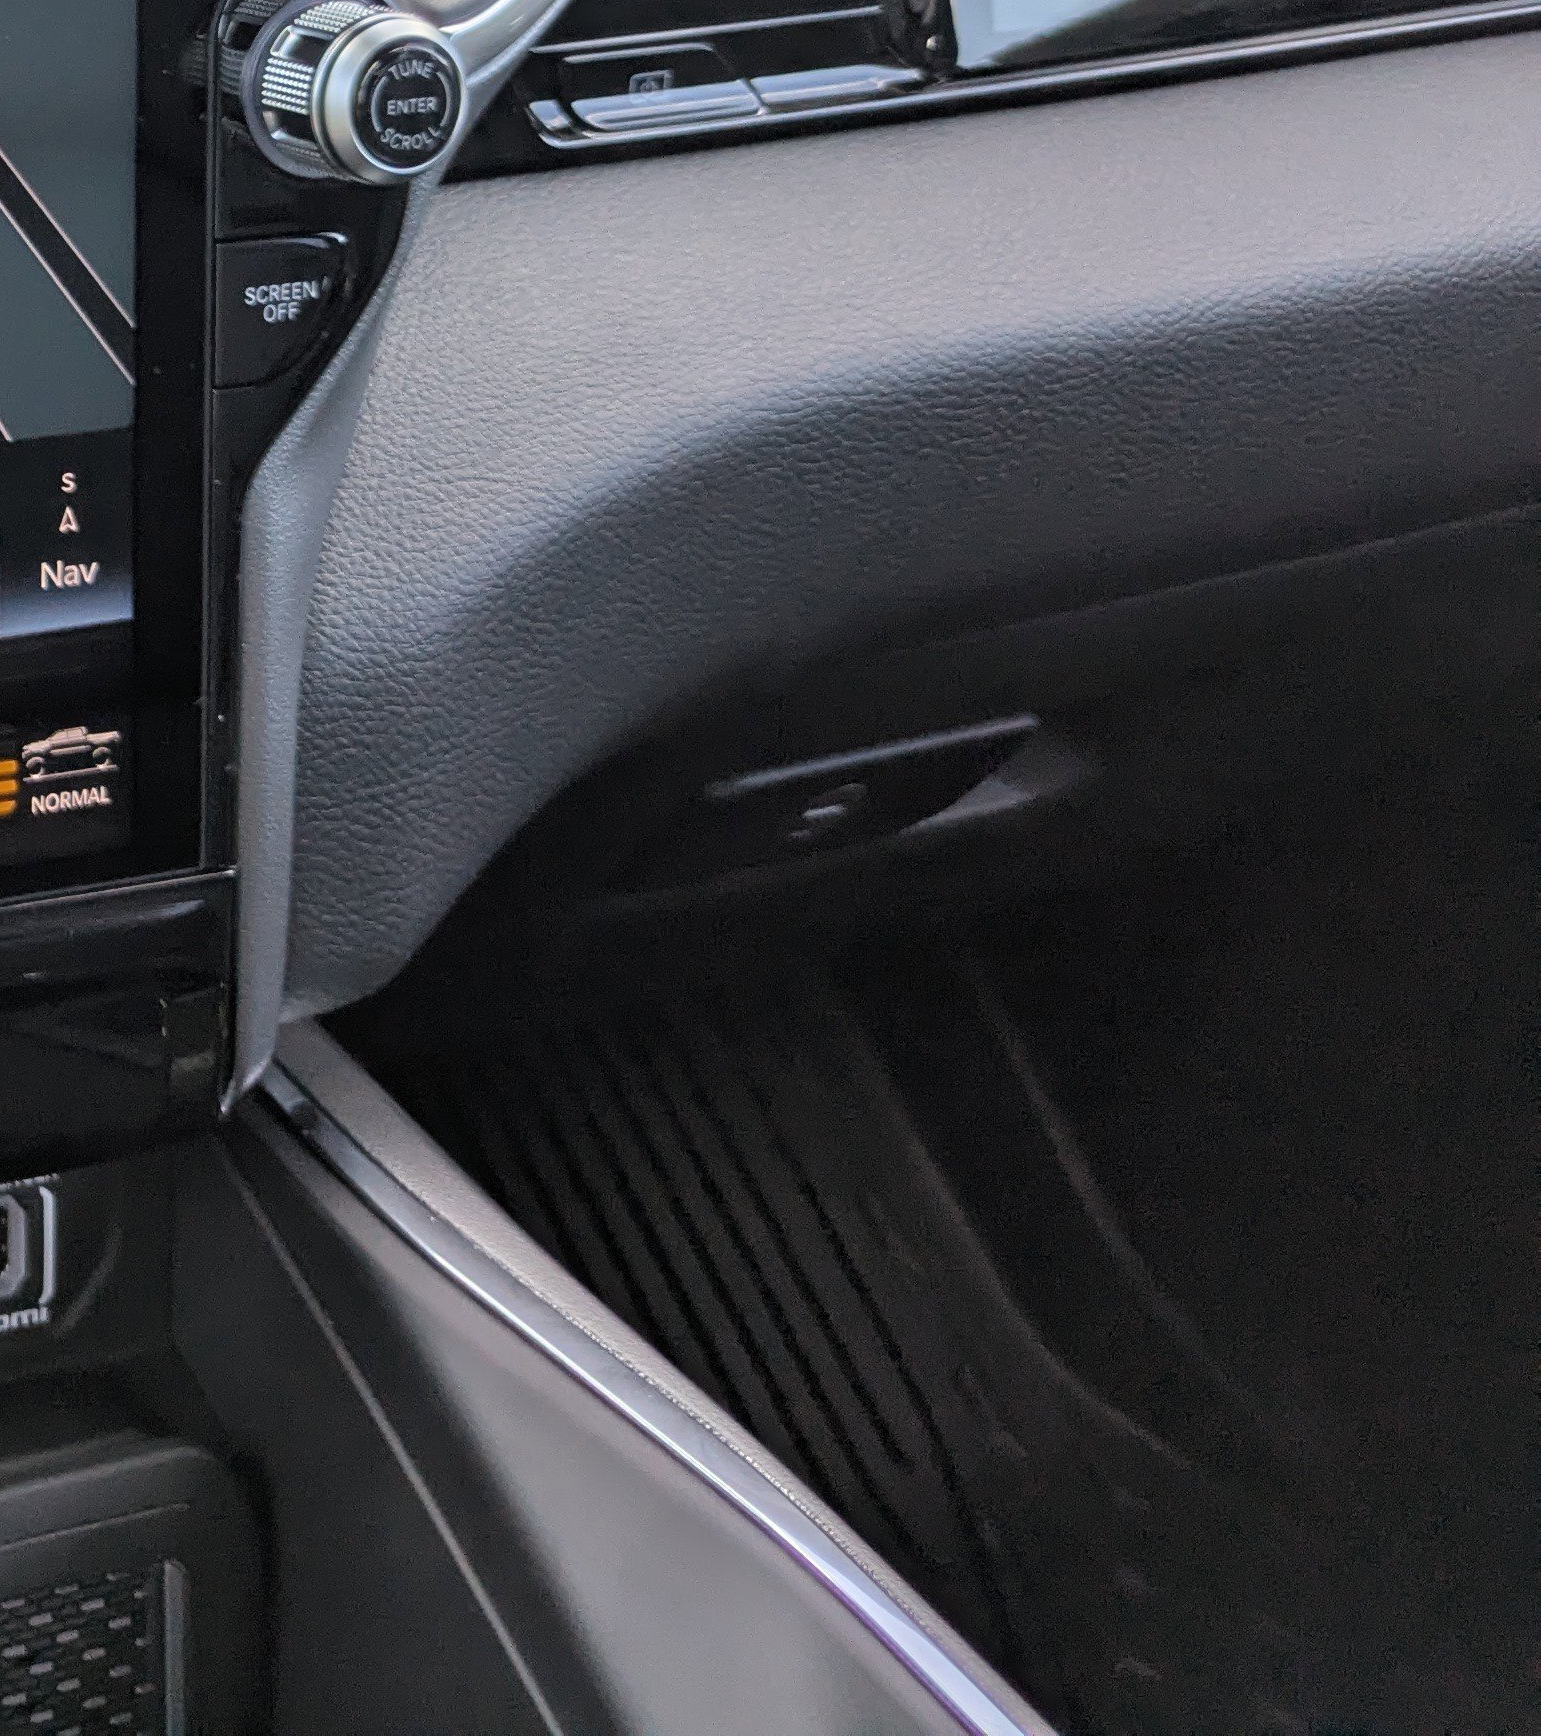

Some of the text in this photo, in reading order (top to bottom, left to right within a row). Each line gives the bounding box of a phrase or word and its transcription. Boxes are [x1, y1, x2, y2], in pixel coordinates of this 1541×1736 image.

[387, 59, 435, 81] TUNE
[387, 98, 438, 117] ENTER
[379, 126, 445, 152] SCROLL
[244, 280, 317, 305] SCREEN
[263, 301, 302, 323] OFF
[61, 471, 77, 494] S
[40, 559, 100, 590] Nav
[30, 784, 112, 816] NORMAL
